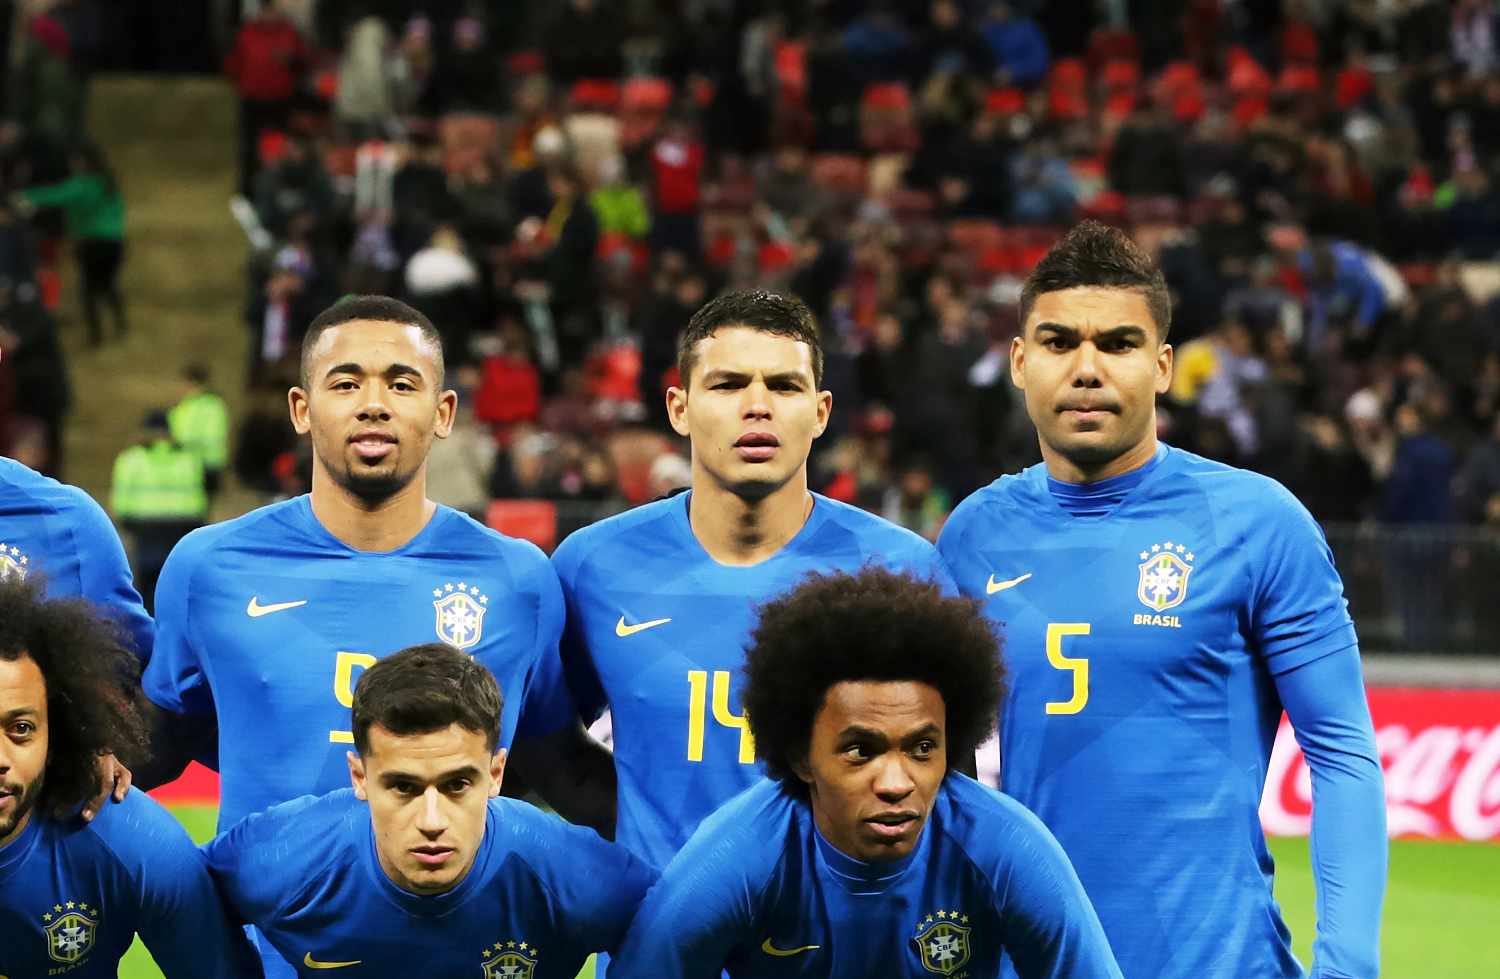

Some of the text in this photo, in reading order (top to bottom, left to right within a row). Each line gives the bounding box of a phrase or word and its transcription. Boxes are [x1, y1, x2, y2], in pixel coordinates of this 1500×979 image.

[1133, 613, 1182, 628] BRASIL
[1045, 622, 1091, 715] 5
[687, 670, 756, 764] 14
[936, 943, 955, 952] CBF
